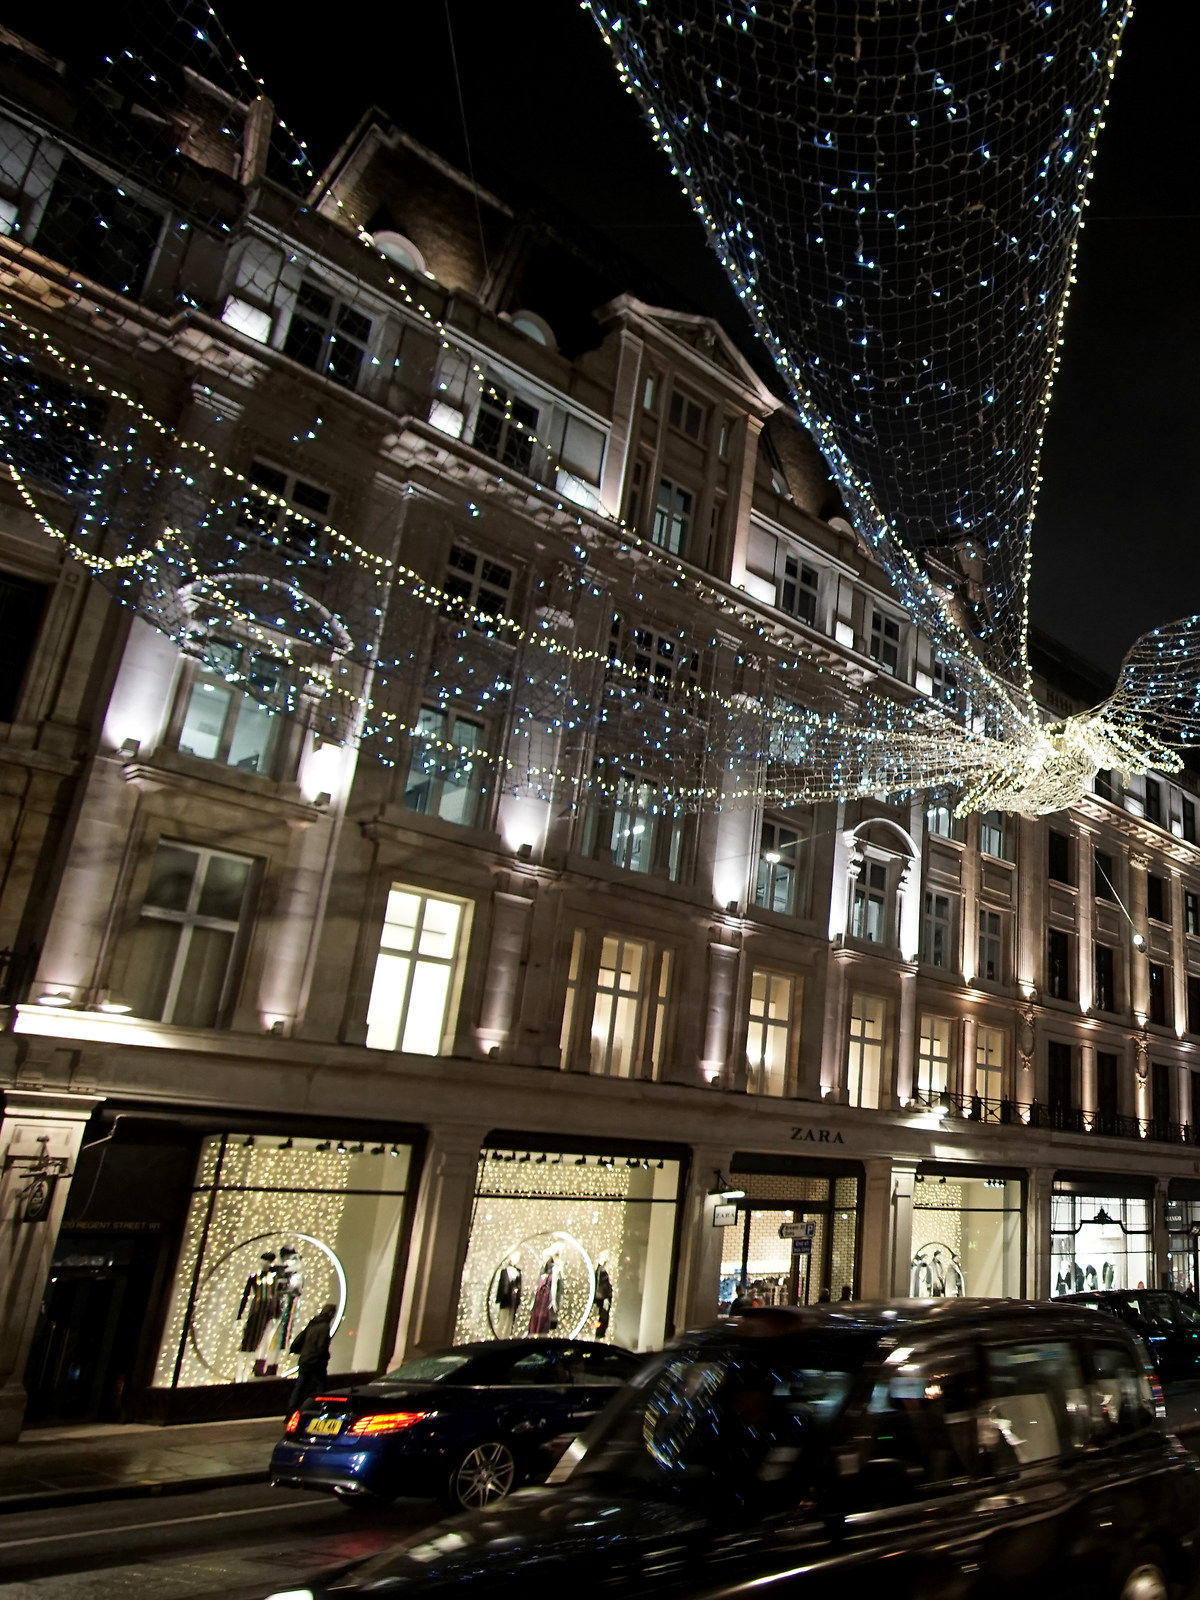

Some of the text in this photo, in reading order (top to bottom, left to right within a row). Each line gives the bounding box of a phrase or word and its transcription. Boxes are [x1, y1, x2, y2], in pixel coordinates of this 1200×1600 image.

[791, 1127, 844, 1144] ZARA
[75, 1221, 111, 1230] REGENT
[112, 1221, 146, 1230] STREET
